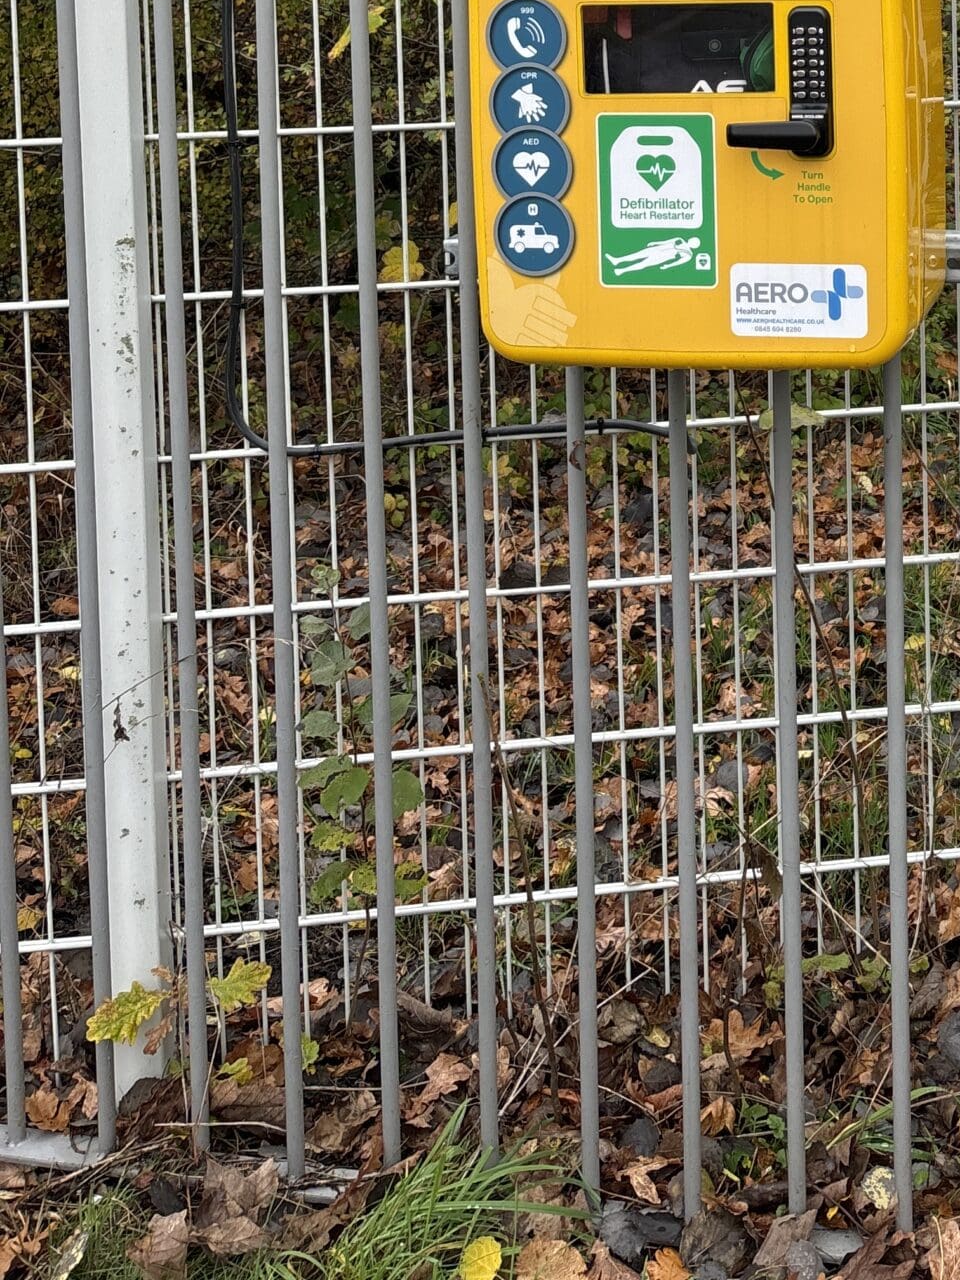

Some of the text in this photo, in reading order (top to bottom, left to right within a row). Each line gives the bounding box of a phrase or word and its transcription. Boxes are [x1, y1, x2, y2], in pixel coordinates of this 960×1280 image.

[522, 138, 540, 146] AED
[801, 171, 824, 180] Turn
[797, 183, 831, 191] Handle
[620, 198, 695, 210] Defibrillator
[793, 195, 833, 205] To Open
[620, 211, 695, 220] Heart Restarter
[736, 282, 809, 304] AERO
[736, 307, 777, 315] Healthcare
